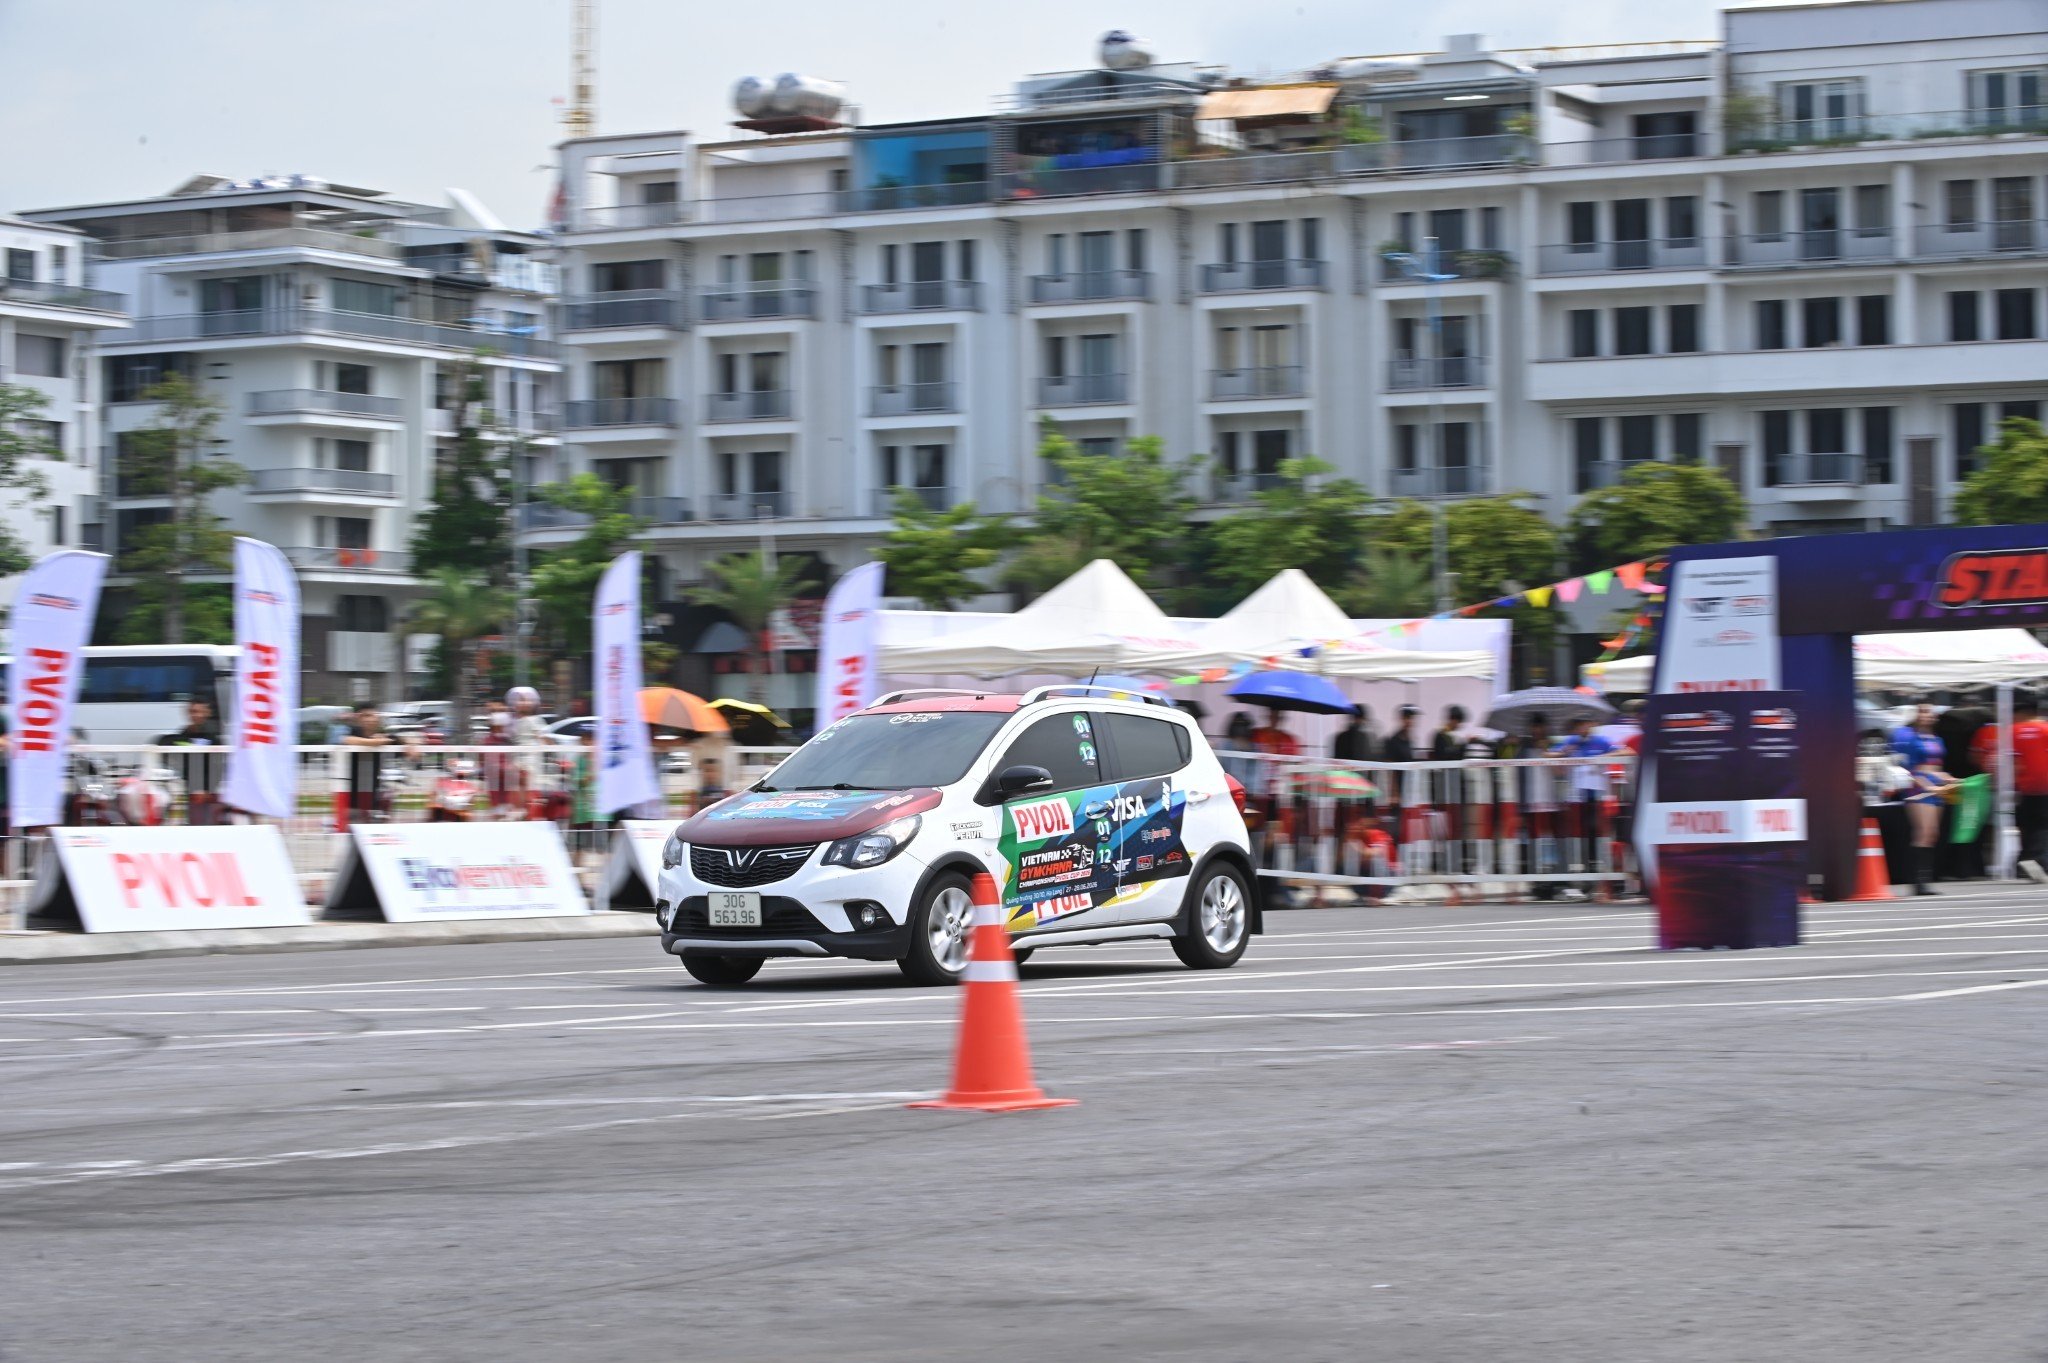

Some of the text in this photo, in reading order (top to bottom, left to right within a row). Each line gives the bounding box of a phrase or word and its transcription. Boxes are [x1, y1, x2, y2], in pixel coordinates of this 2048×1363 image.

[1075, 719, 1090, 734] 01
[1080, 746, 1096, 761] 12
[1104, 795, 1148, 821] VISA
[1014, 803, 1069, 837] PVOIL
[1097, 820, 1110, 835] 01
[1099, 848, 1111, 864] 12
[110, 853, 264, 908] PVOIL
[723, 894, 746, 908] 30G
[714, 909, 756, 924] 563.96
